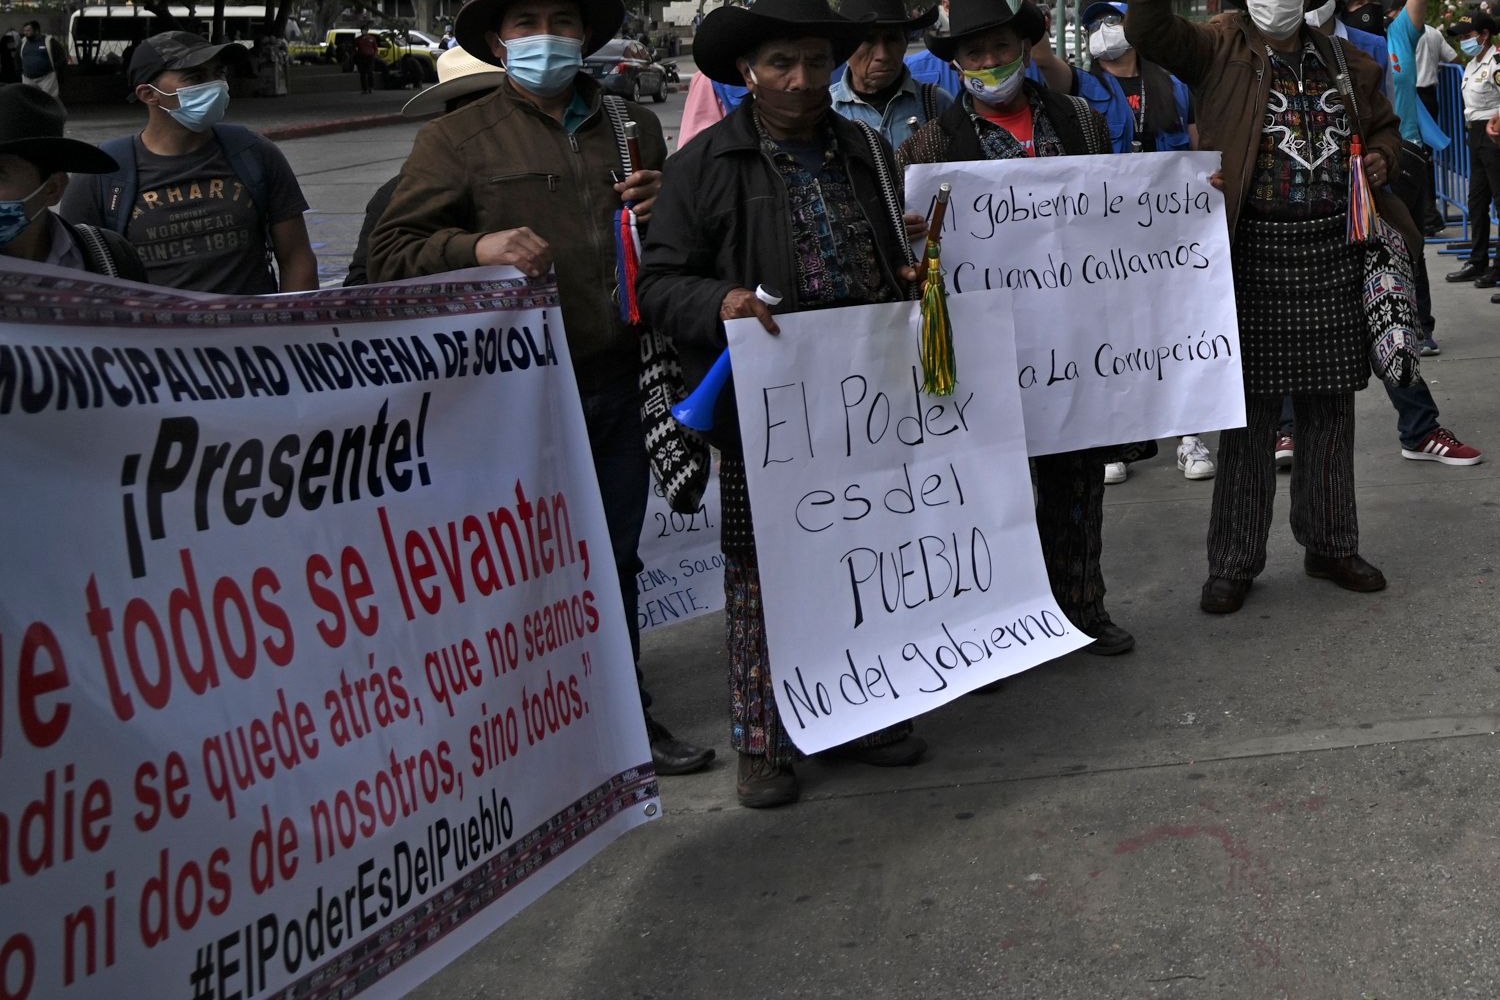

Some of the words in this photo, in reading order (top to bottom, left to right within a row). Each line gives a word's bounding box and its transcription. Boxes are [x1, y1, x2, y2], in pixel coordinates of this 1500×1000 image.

[137, 237, 197, 262] SINCE
[205, 228, 250, 252] 1889
[145, 214, 235, 241] WORKWEAR
[970, 185, 1090, 240] gobierno
[1102, 180, 1125, 218] le
[1136, 181, 1213, 228] gusta
[284, 326, 440, 393] INDÍGENA
[433, 329, 469, 379] DE
[472, 309, 559, 377] SOLOLÁ
[1046, 348, 1080, 387] La
[1094, 330, 1232, 381] Corrupción
[762, 380, 814, 469] El
[840, 364, 974, 457] Poder
[120, 391, 432, 580] ¡Presente!
[0, 620, 72, 760] e
[85, 547, 295, 723] todos
[306, 544, 380, 649] se
[377, 476, 590, 622] levanten,
[637, 567, 678, 596] ENA,
[839, 526, 993, 630] PUEBLO
[133, 750, 191, 832] se
[202, 688, 320, 820] quede
[324, 652, 425, 748] atrás,
[424, 637, 484, 718] que
[485, 620, 520, 679] no
[523, 589, 601, 663] seamos
[783, 666, 832, 730] No
[839, 648, 900, 706] del
[63, 868, 117, 988] ni
[138, 847, 233, 949] dos
[249, 803, 300, 896] de
[310, 739, 465, 865] nosotros,
[469, 702, 520, 778] sino
[189, 787, 515, 1000] #ElPoderEsDelPueblo
